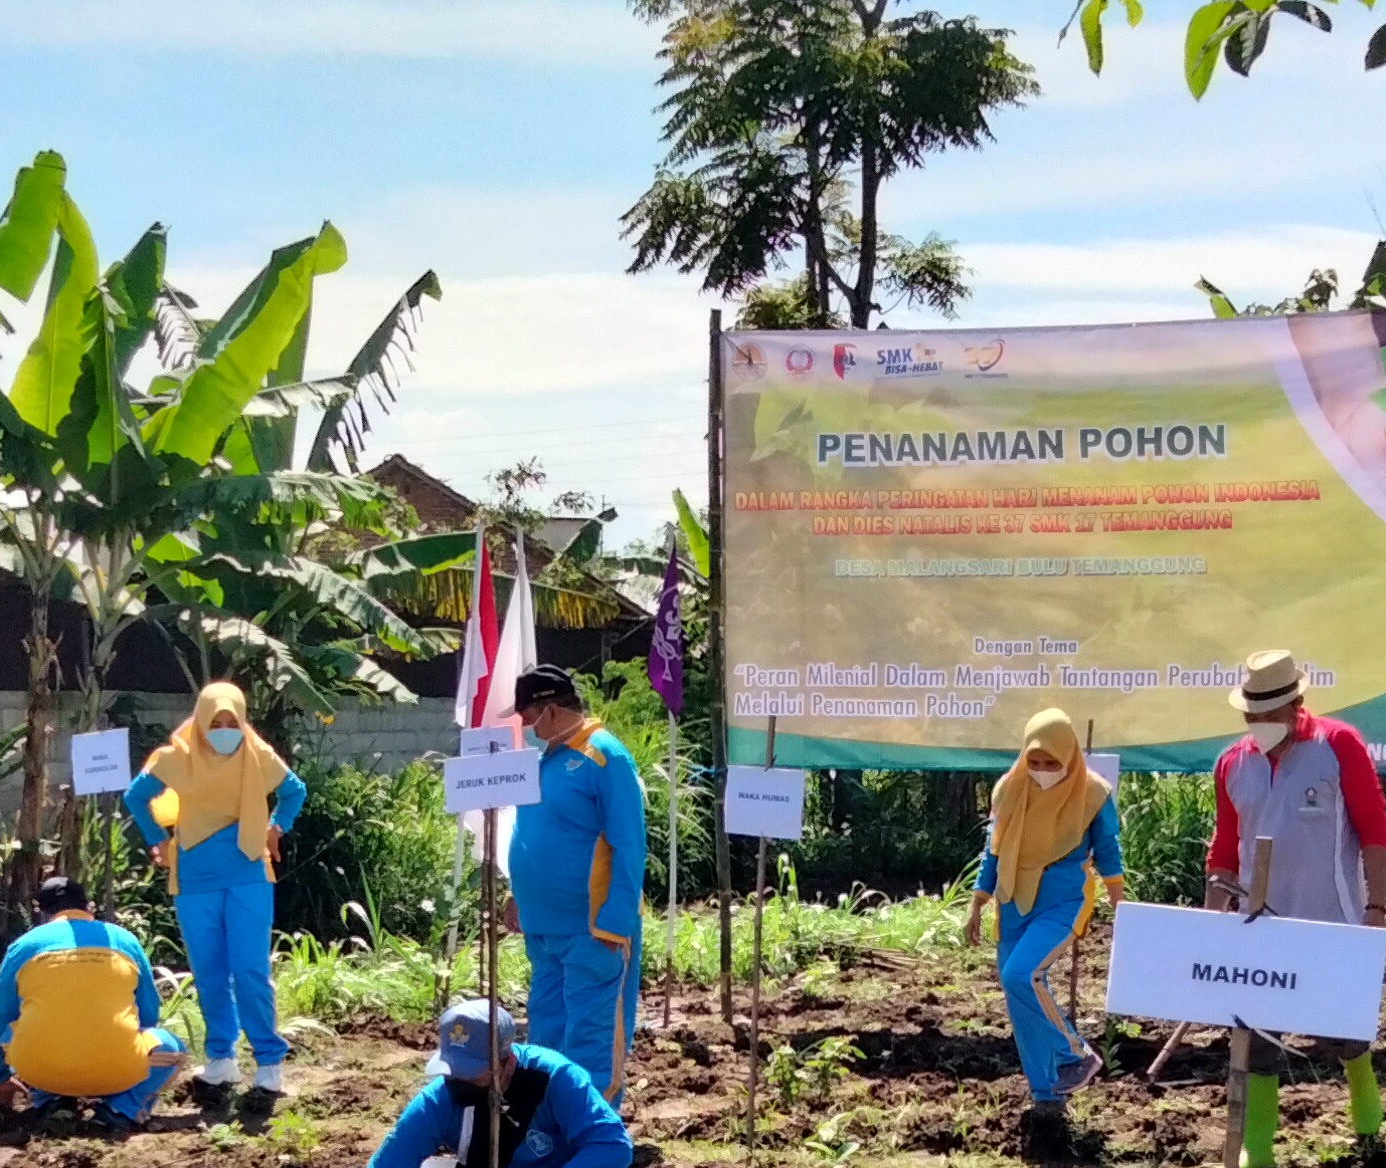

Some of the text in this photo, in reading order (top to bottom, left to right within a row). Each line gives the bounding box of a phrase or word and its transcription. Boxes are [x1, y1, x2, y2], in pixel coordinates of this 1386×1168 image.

[877, 347, 913, 366] SMK
[885, 361, 944, 375] BISA-HEBAT
[817, 424, 1227, 465] PENANAMAN POHON
[735, 479, 1321, 510] DALAM RANGKA PERINGATAN HARI MENANAM POHON INDONESIA
[813, 508, 1233, 535] DAN DIES NATALIS KE 37 SMK 17 TEMANGGUNG
[835, 555, 1208, 578] DESA MALANGSARI BULU TEMANGGUNG
[974, 637, 1078, 657] Dengan Tema
[807, 663, 877, 687] Milenial
[886, 664, 946, 687] Dalam
[955, 664, 1051, 692] Menjawab
[1060, 666, 1159, 692] Tantangan
[735, 692, 803, 716] Melalui
[812, 694, 917, 717] Penanaman
[456, 772, 526, 790] JERUK KEPROK
[737, 791, 760, 800] WAKA
[1191, 962, 1298, 990] MAHONI
